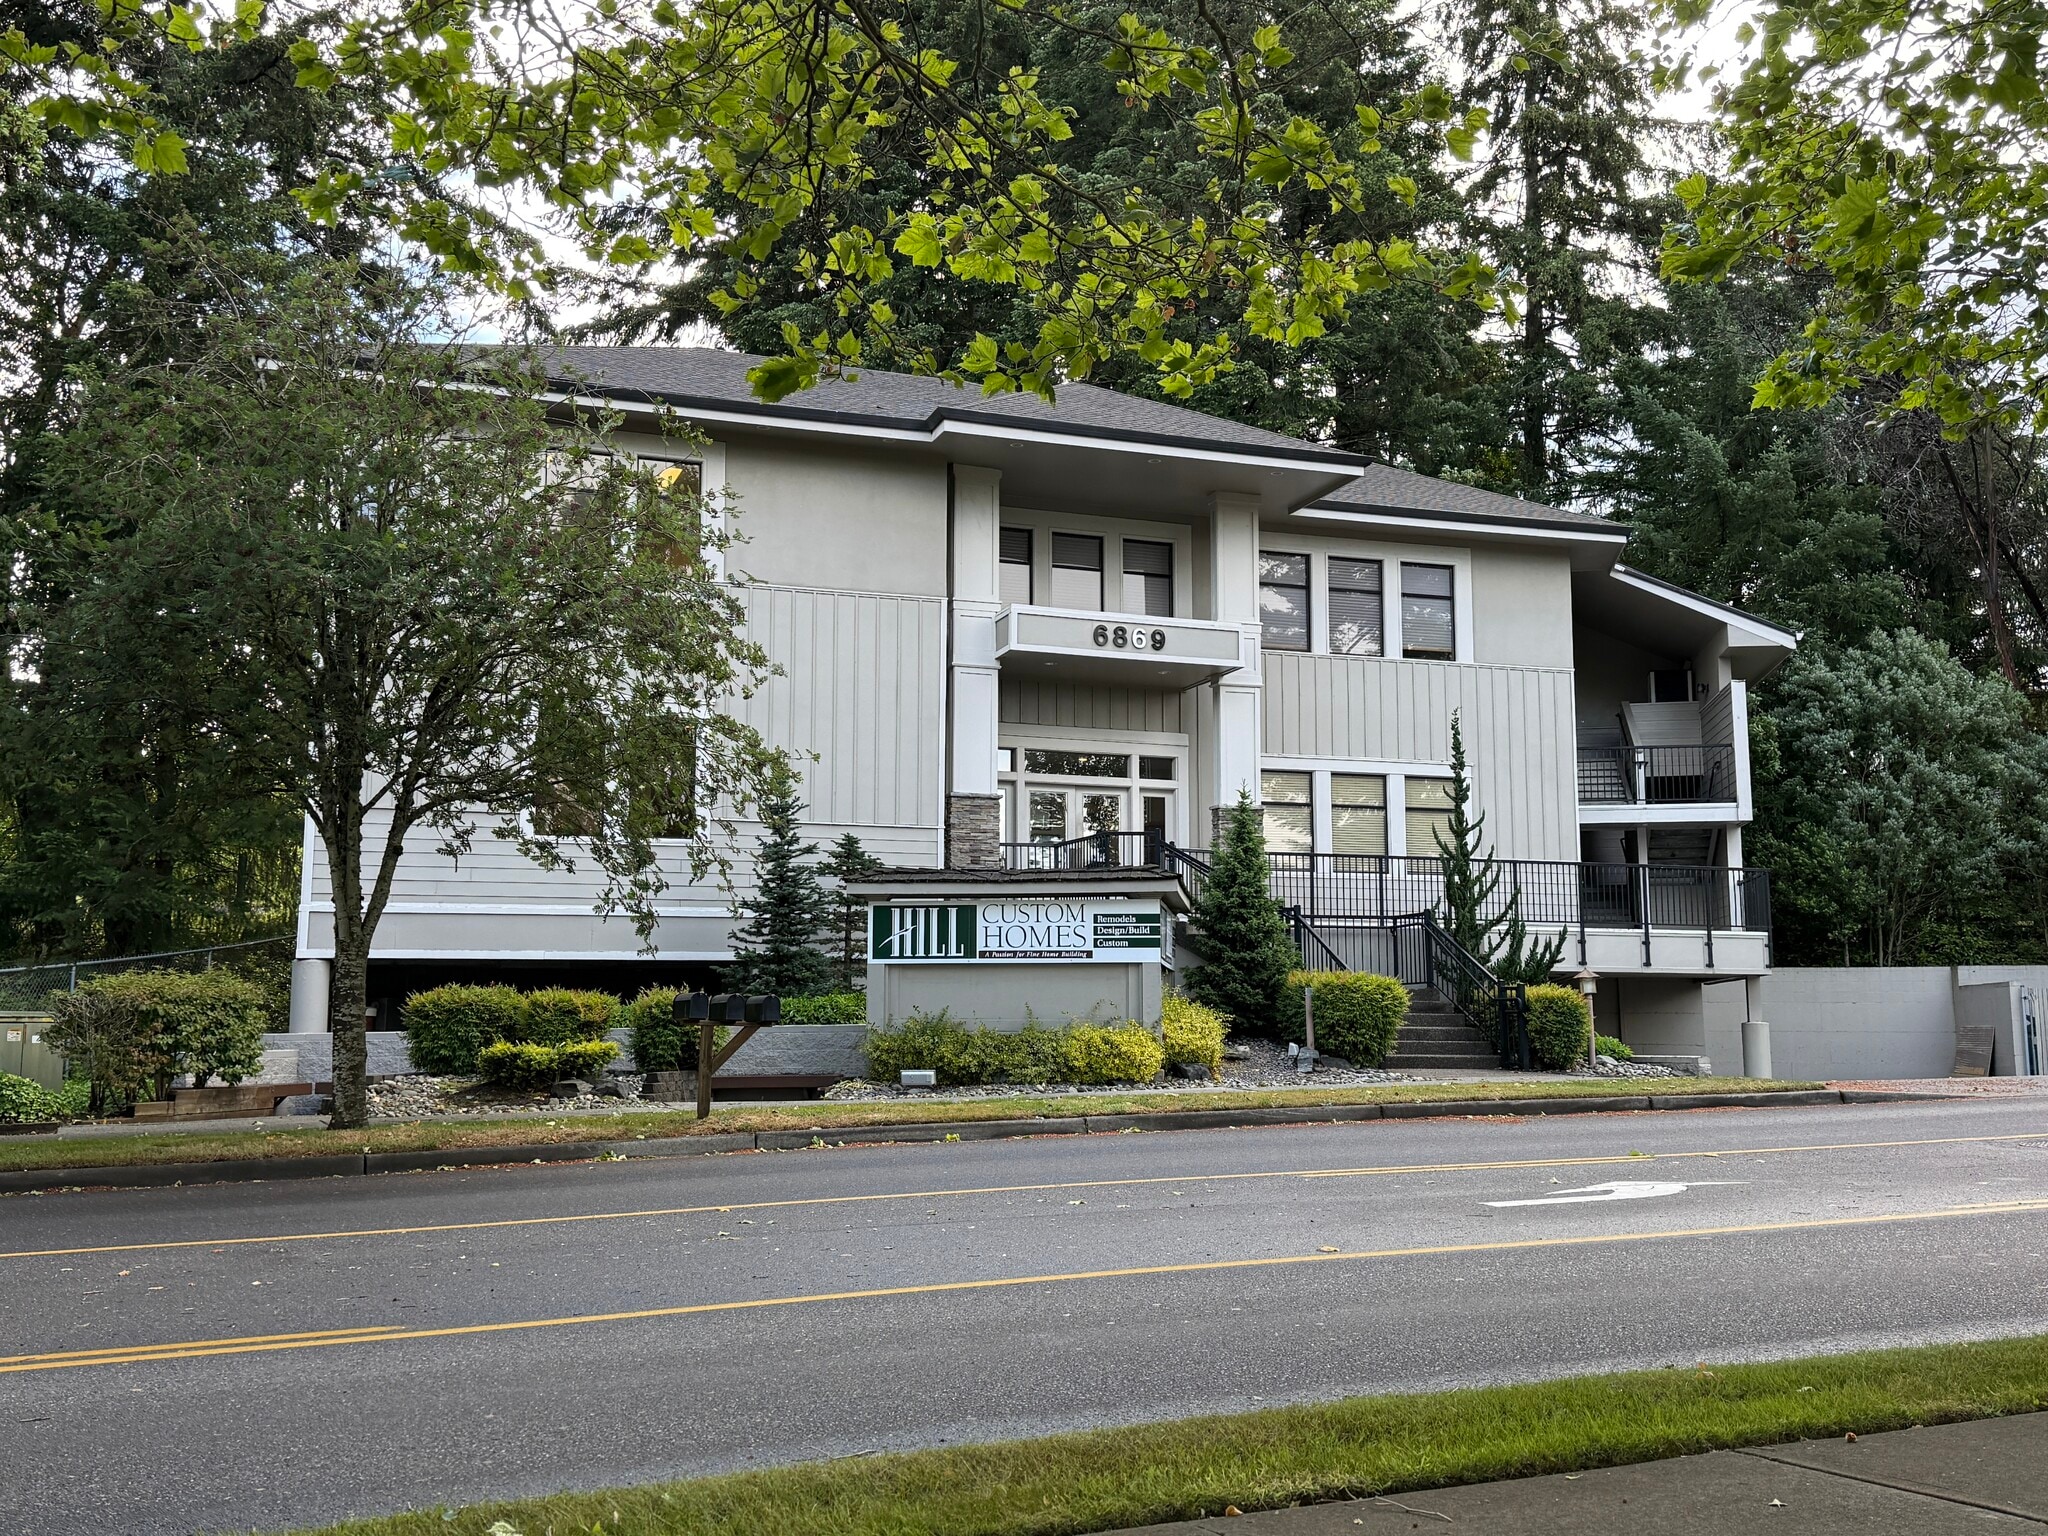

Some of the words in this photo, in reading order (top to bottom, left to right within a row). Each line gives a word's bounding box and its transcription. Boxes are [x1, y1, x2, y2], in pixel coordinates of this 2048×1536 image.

[1093, 624, 1166, 651] 6869
[982, 903, 1086, 924] CUSTOM
[1097, 915, 1136, 923] Remodels
[878, 907, 964, 957] HILL
[982, 925, 1087, 949] HOMES
[1097, 926, 1150, 936] Design/Build
[1097, 939, 1129, 947] Custom
